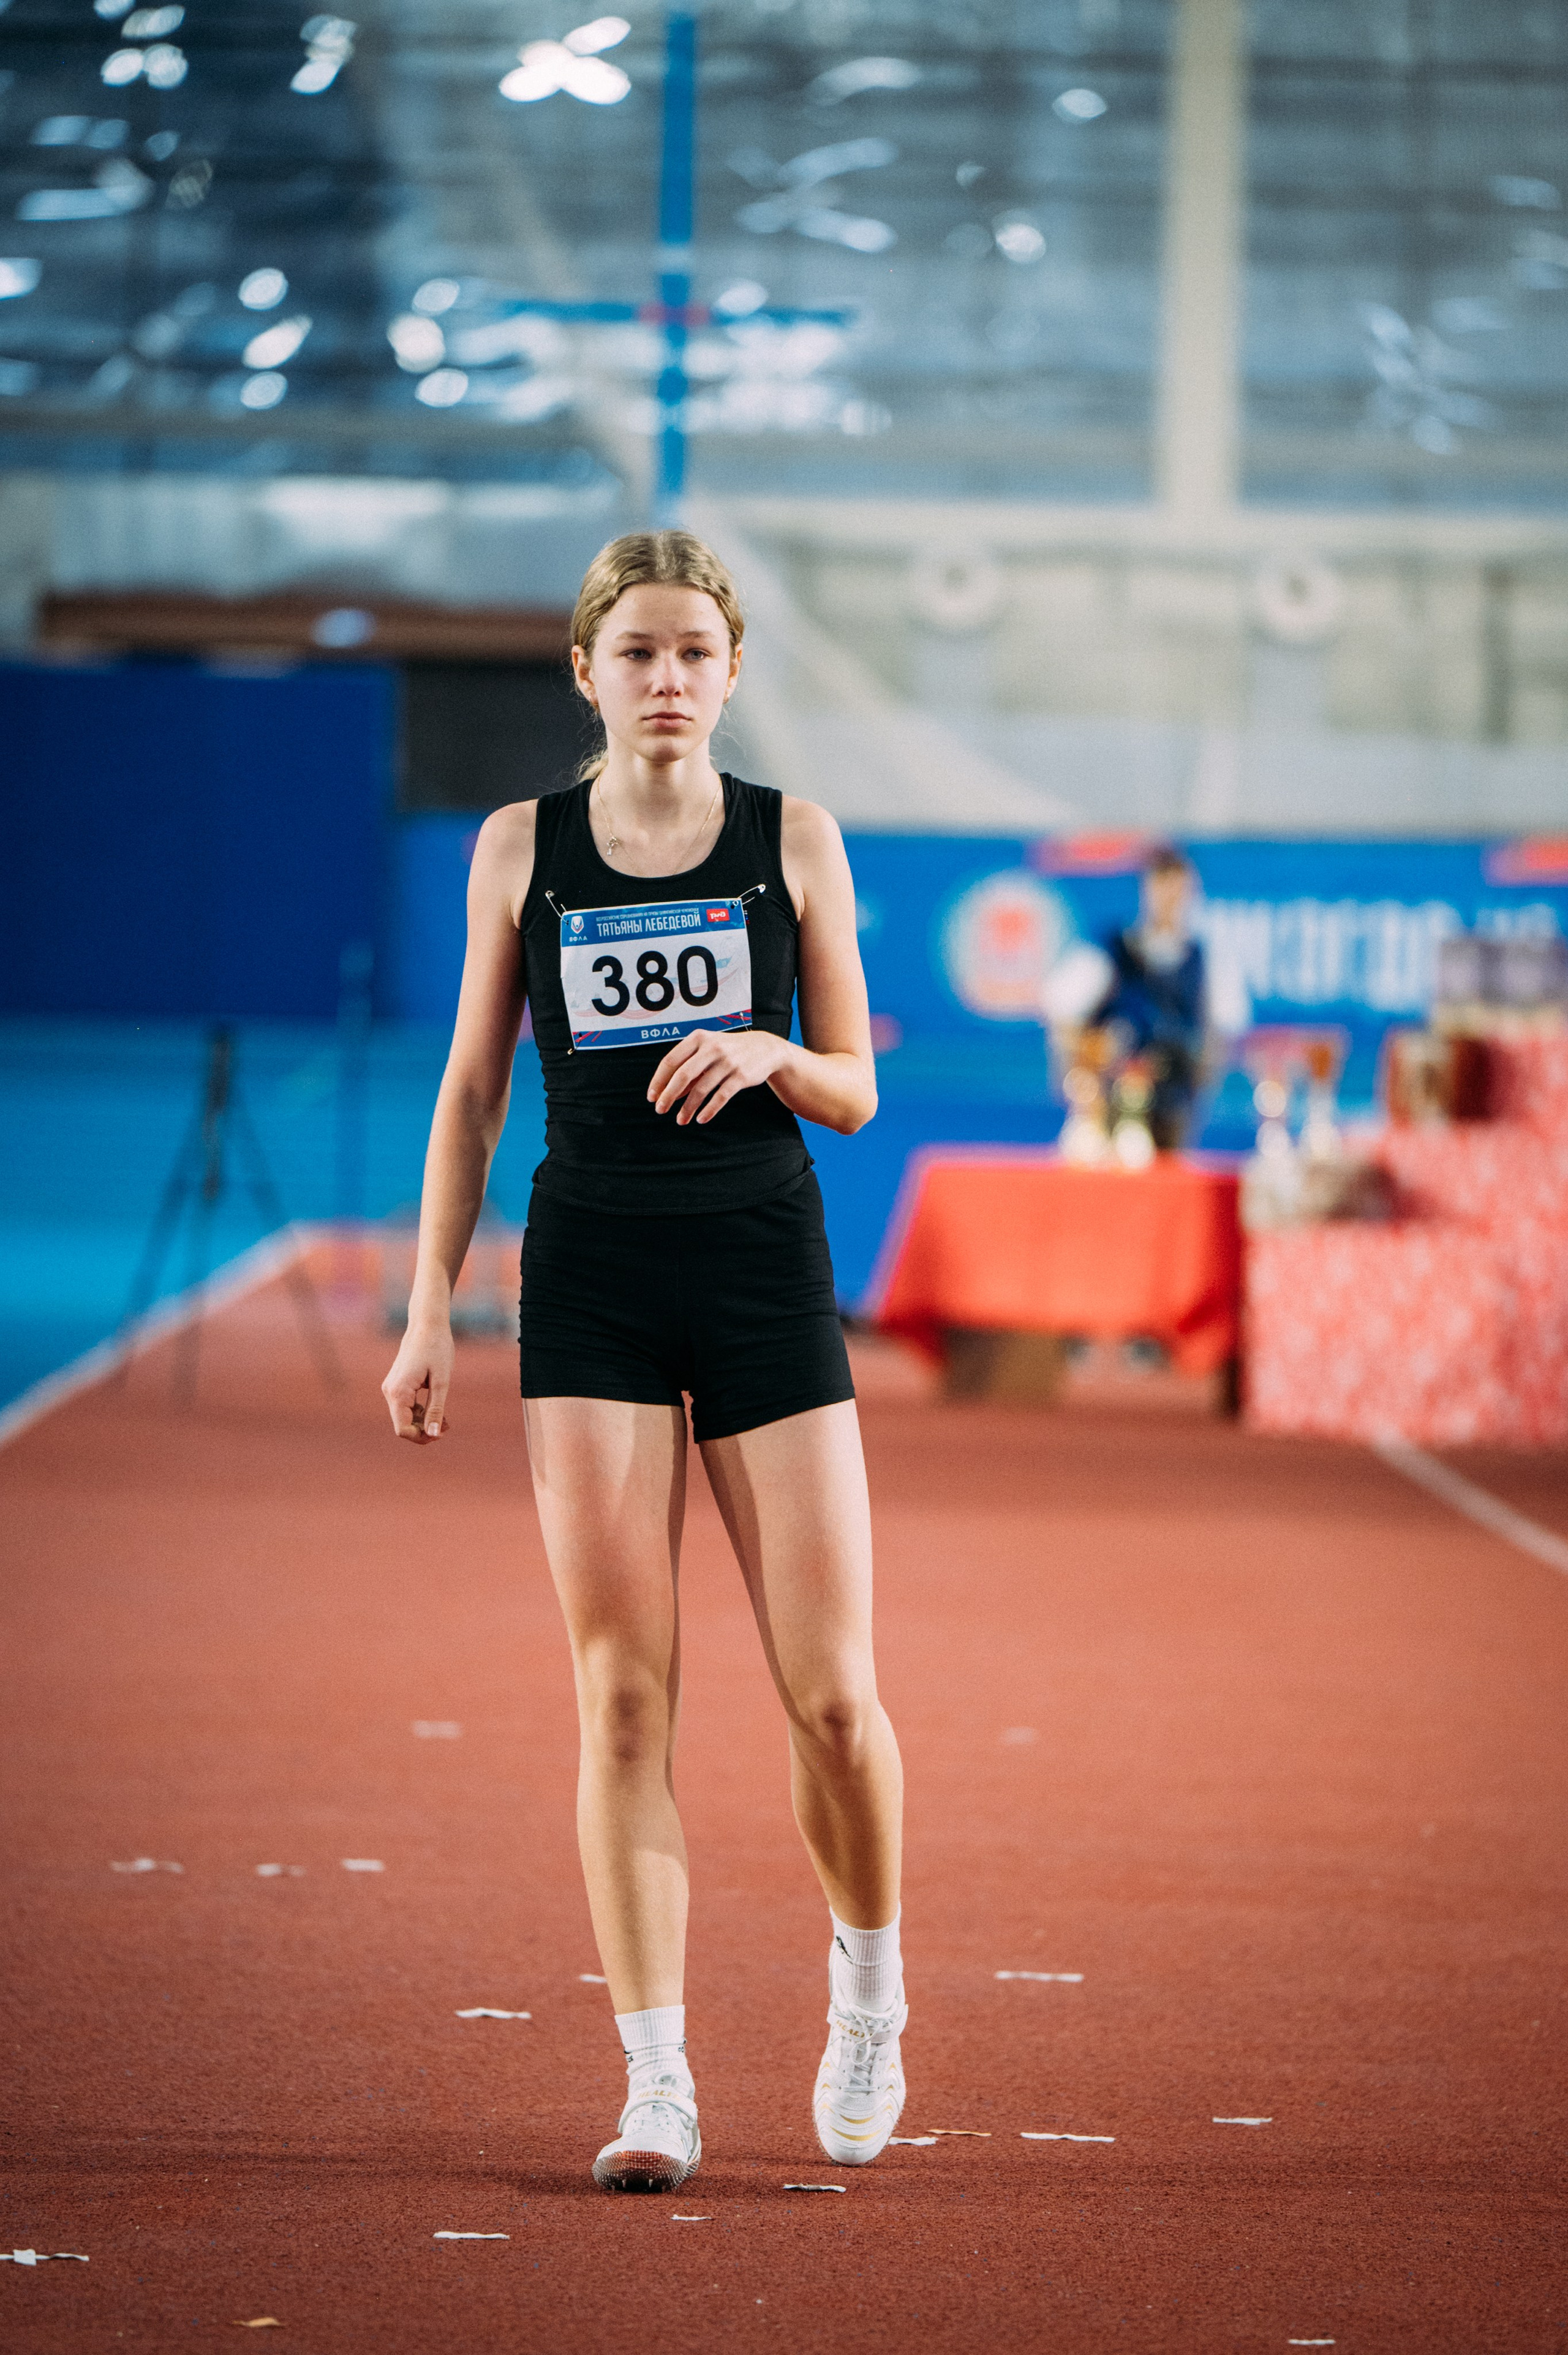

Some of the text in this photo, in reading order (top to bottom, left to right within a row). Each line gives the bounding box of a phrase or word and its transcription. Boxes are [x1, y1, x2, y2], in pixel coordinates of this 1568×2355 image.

[597, 912, 701, 937] ТАТЬЯНЫ ЛЕБЕДЕВОЙ
[592, 945, 718, 1016] 380
[641, 1026, 680, 1039] ВФЛА
